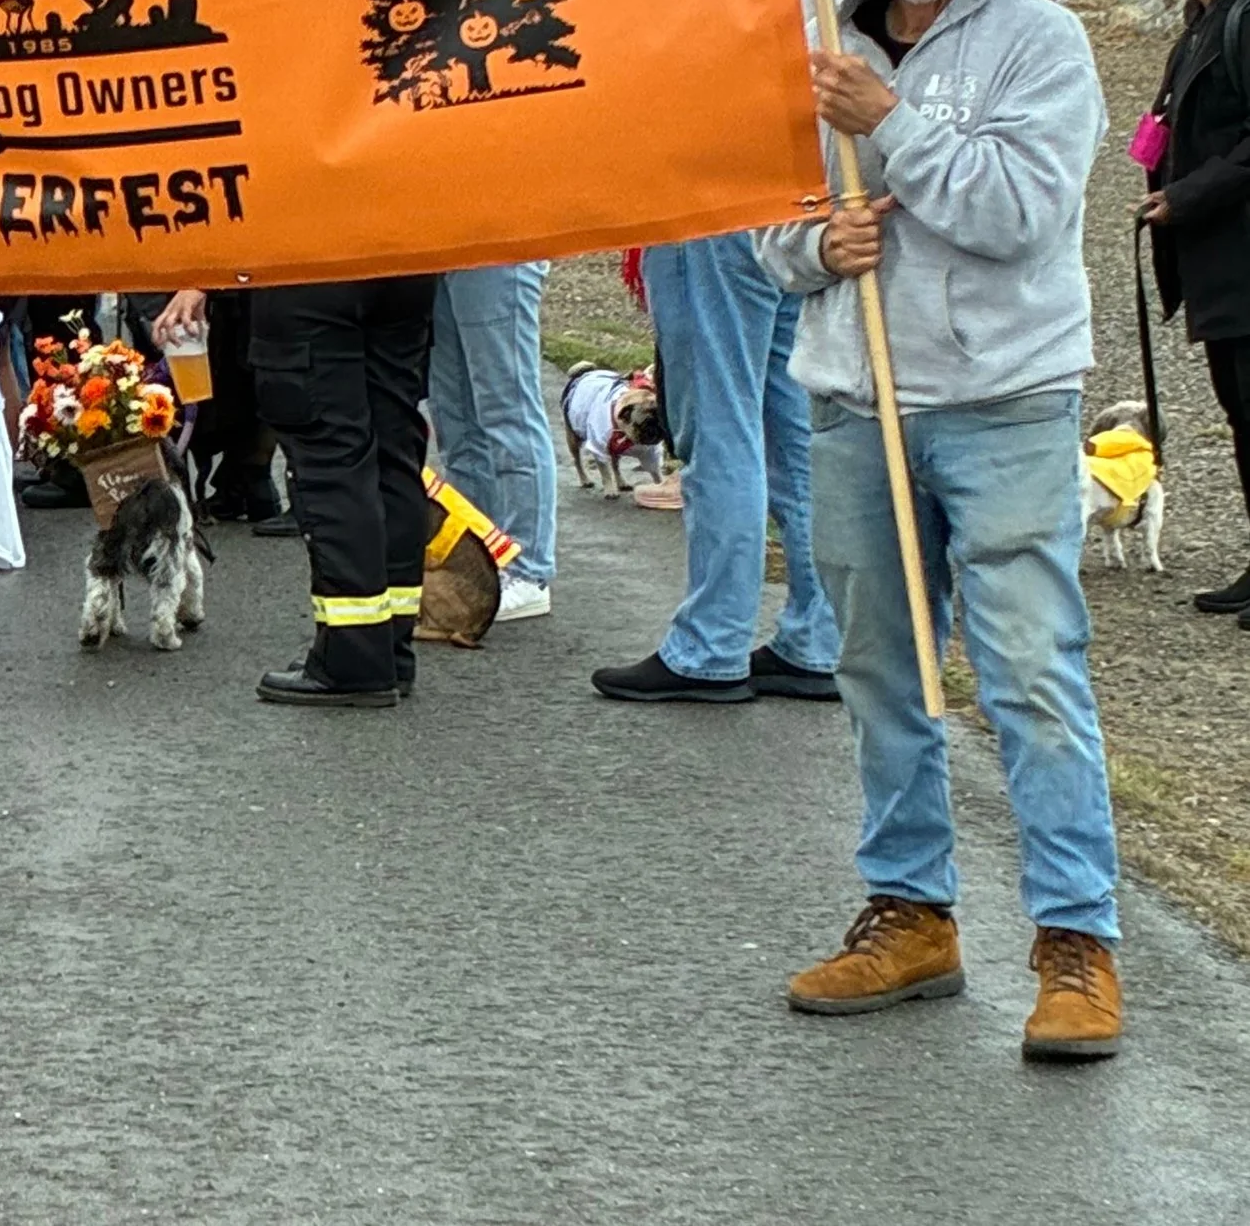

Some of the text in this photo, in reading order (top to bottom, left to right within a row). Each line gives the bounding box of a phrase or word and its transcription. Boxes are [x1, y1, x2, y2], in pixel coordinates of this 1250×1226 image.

[8, 38, 73, 56] 1985
[57, 65, 238, 117] Owners
[918, 103, 972, 123] PIDO
